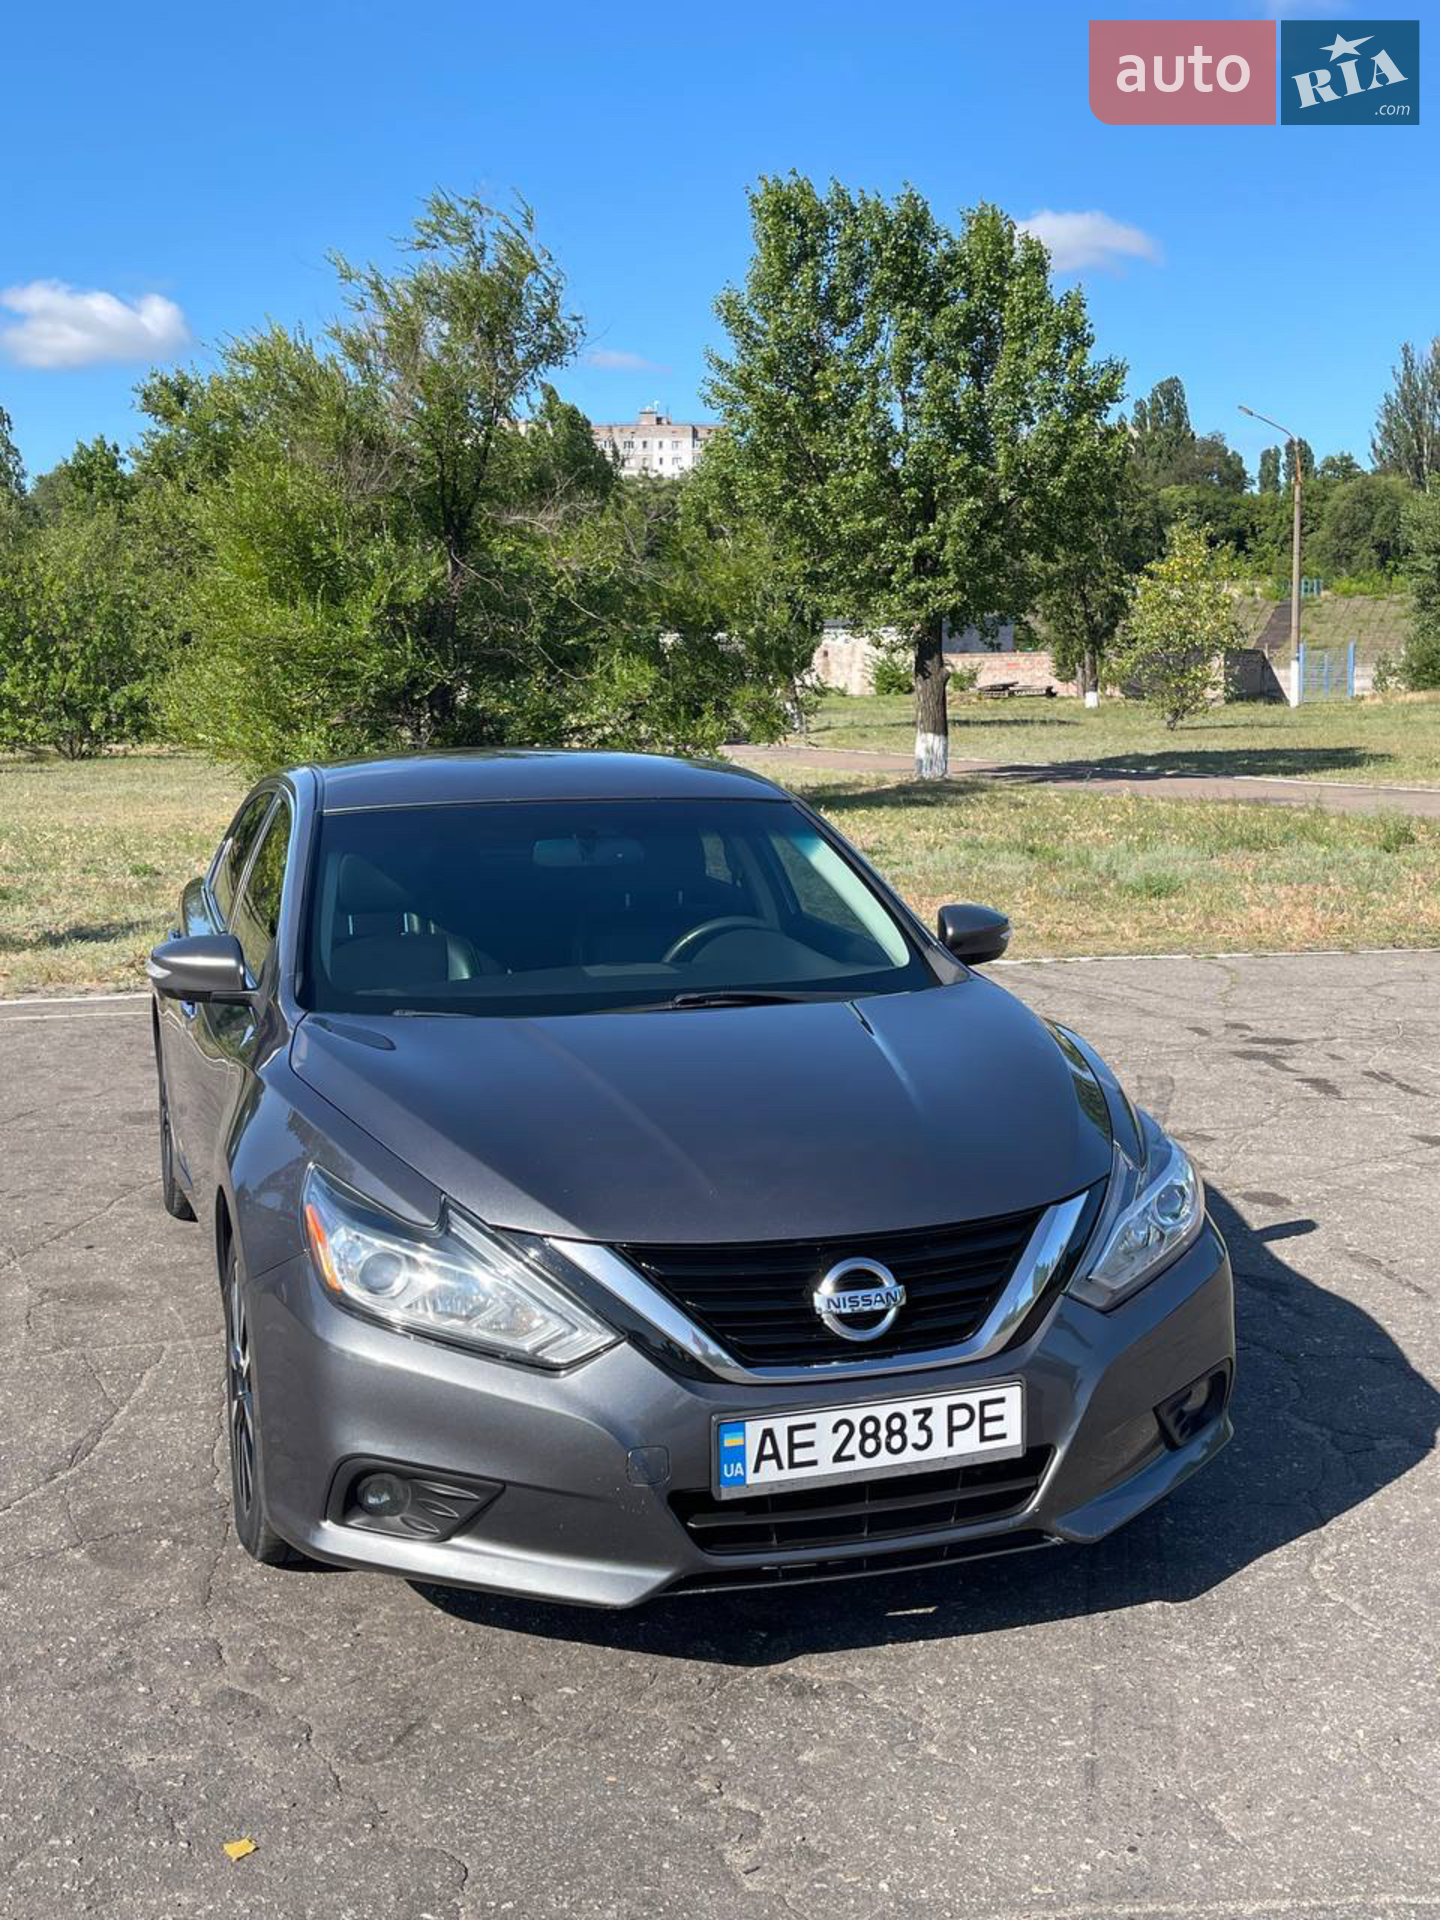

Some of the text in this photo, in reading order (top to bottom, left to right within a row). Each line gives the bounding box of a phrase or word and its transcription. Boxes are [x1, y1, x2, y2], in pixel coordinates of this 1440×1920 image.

[826, 1290, 898, 1309] NISSAN
[752, 1396, 1008, 1474] AE 2883 PE
[723, 1460, 744, 1478] UA
